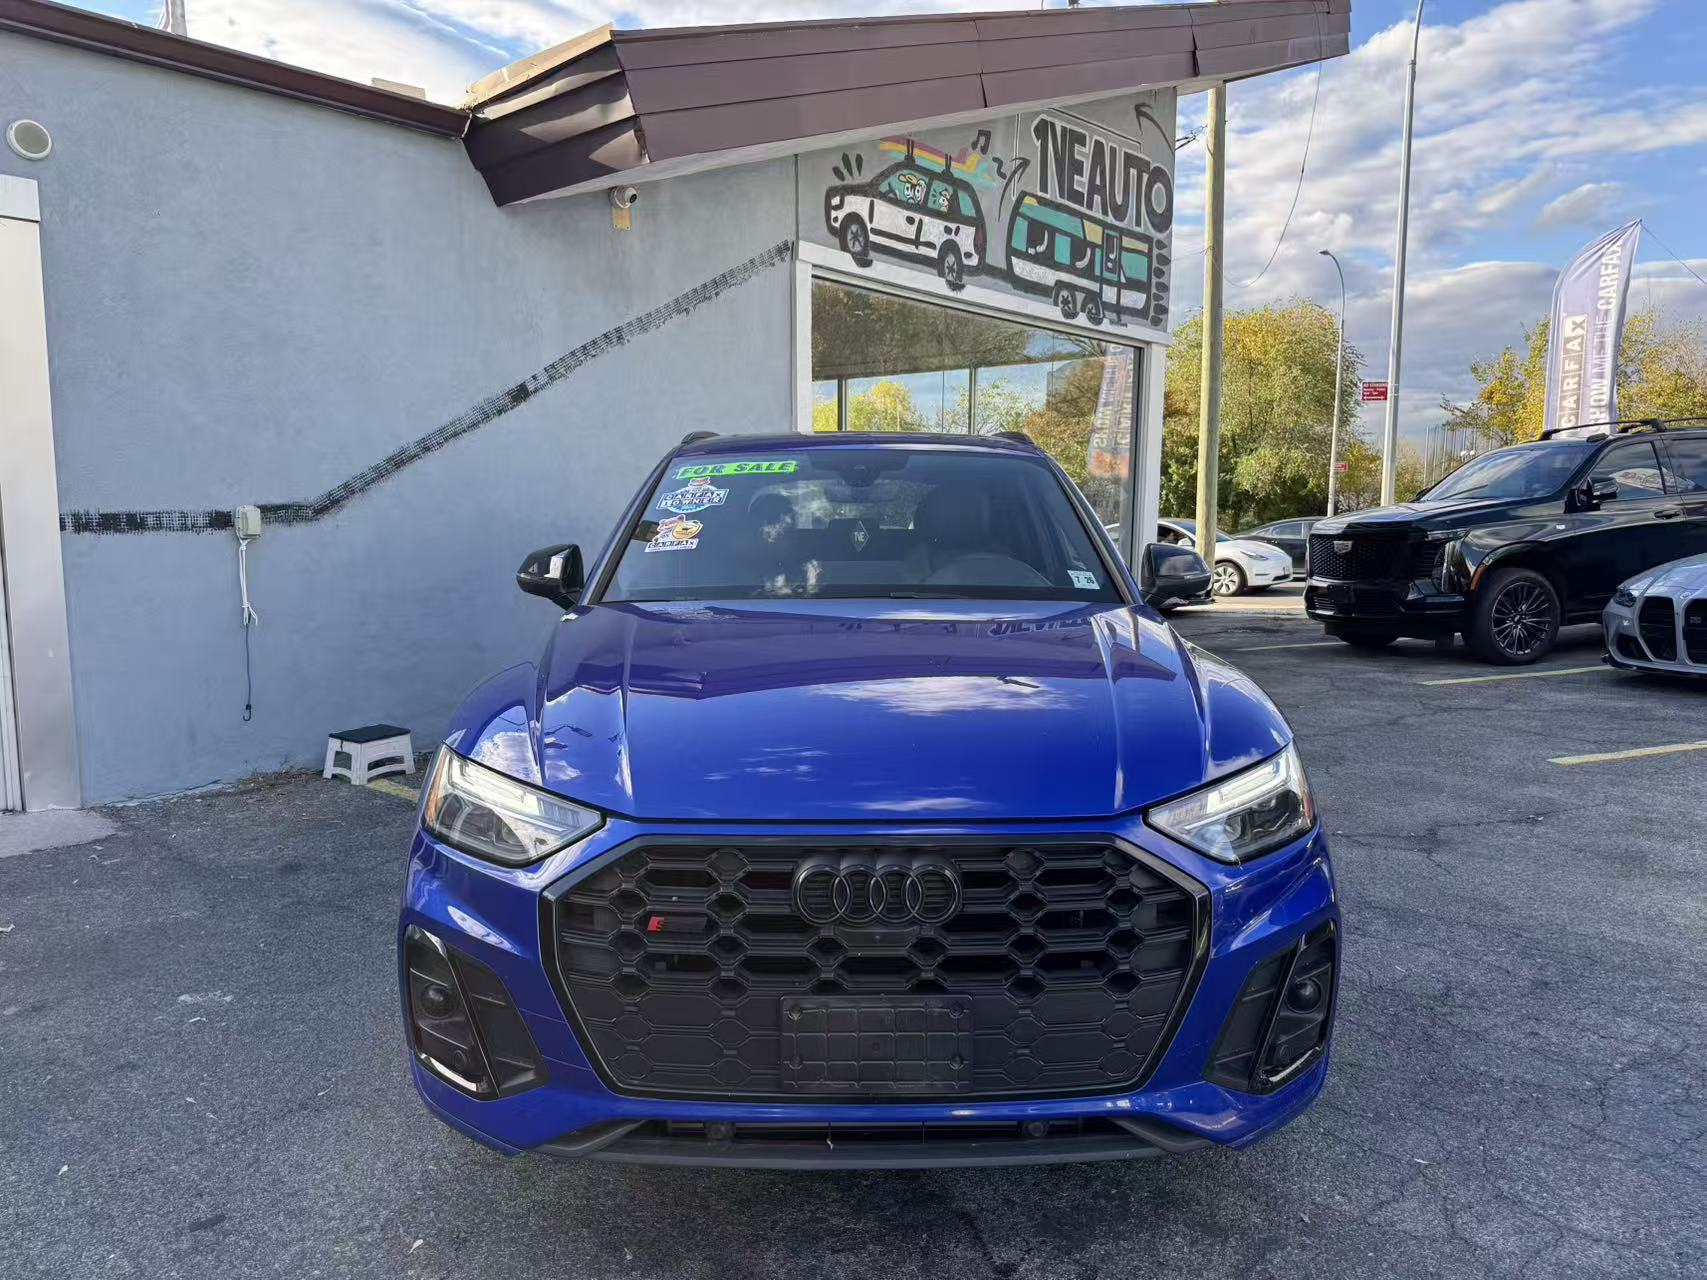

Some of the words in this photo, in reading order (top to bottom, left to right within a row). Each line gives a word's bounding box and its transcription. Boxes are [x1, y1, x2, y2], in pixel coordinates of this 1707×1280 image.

[1594, 314, 1614, 344] THE
[1561, 318, 1586, 427] CARFAX
[1592, 348, 1611, 374] ME
[1589, 379, 1609, 432] SHOW
[679, 465, 725, 477] FOR
[734, 462, 794, 473] SALE
[664, 491, 722, 501] CARFAX
[648, 540, 695, 549] CARFAX
